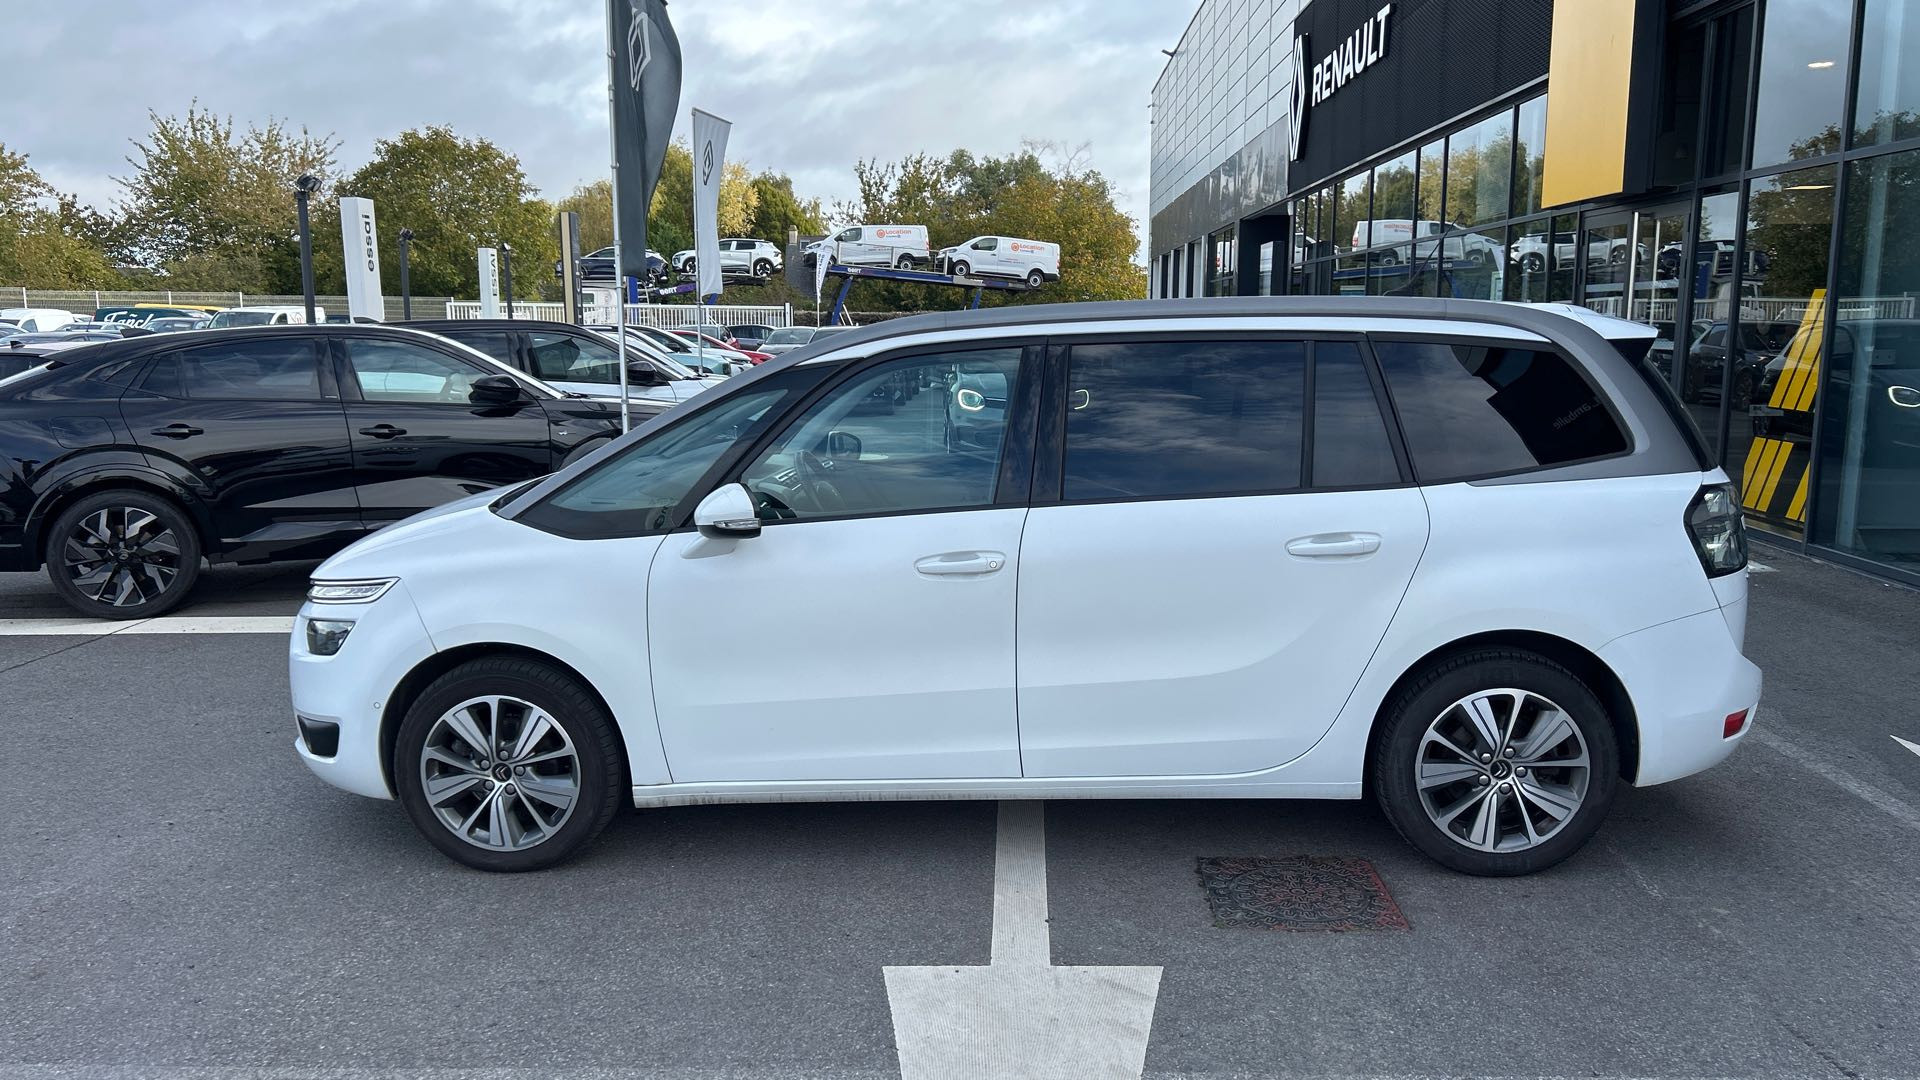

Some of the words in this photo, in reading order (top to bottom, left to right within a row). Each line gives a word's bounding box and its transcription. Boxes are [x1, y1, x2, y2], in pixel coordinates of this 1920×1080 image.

[1311, 3, 1391, 107] RENAULT
[361, 214, 375, 272] essai
[1019, 243, 1046, 252] Location
[490, 253, 498, 297] ESSAI
